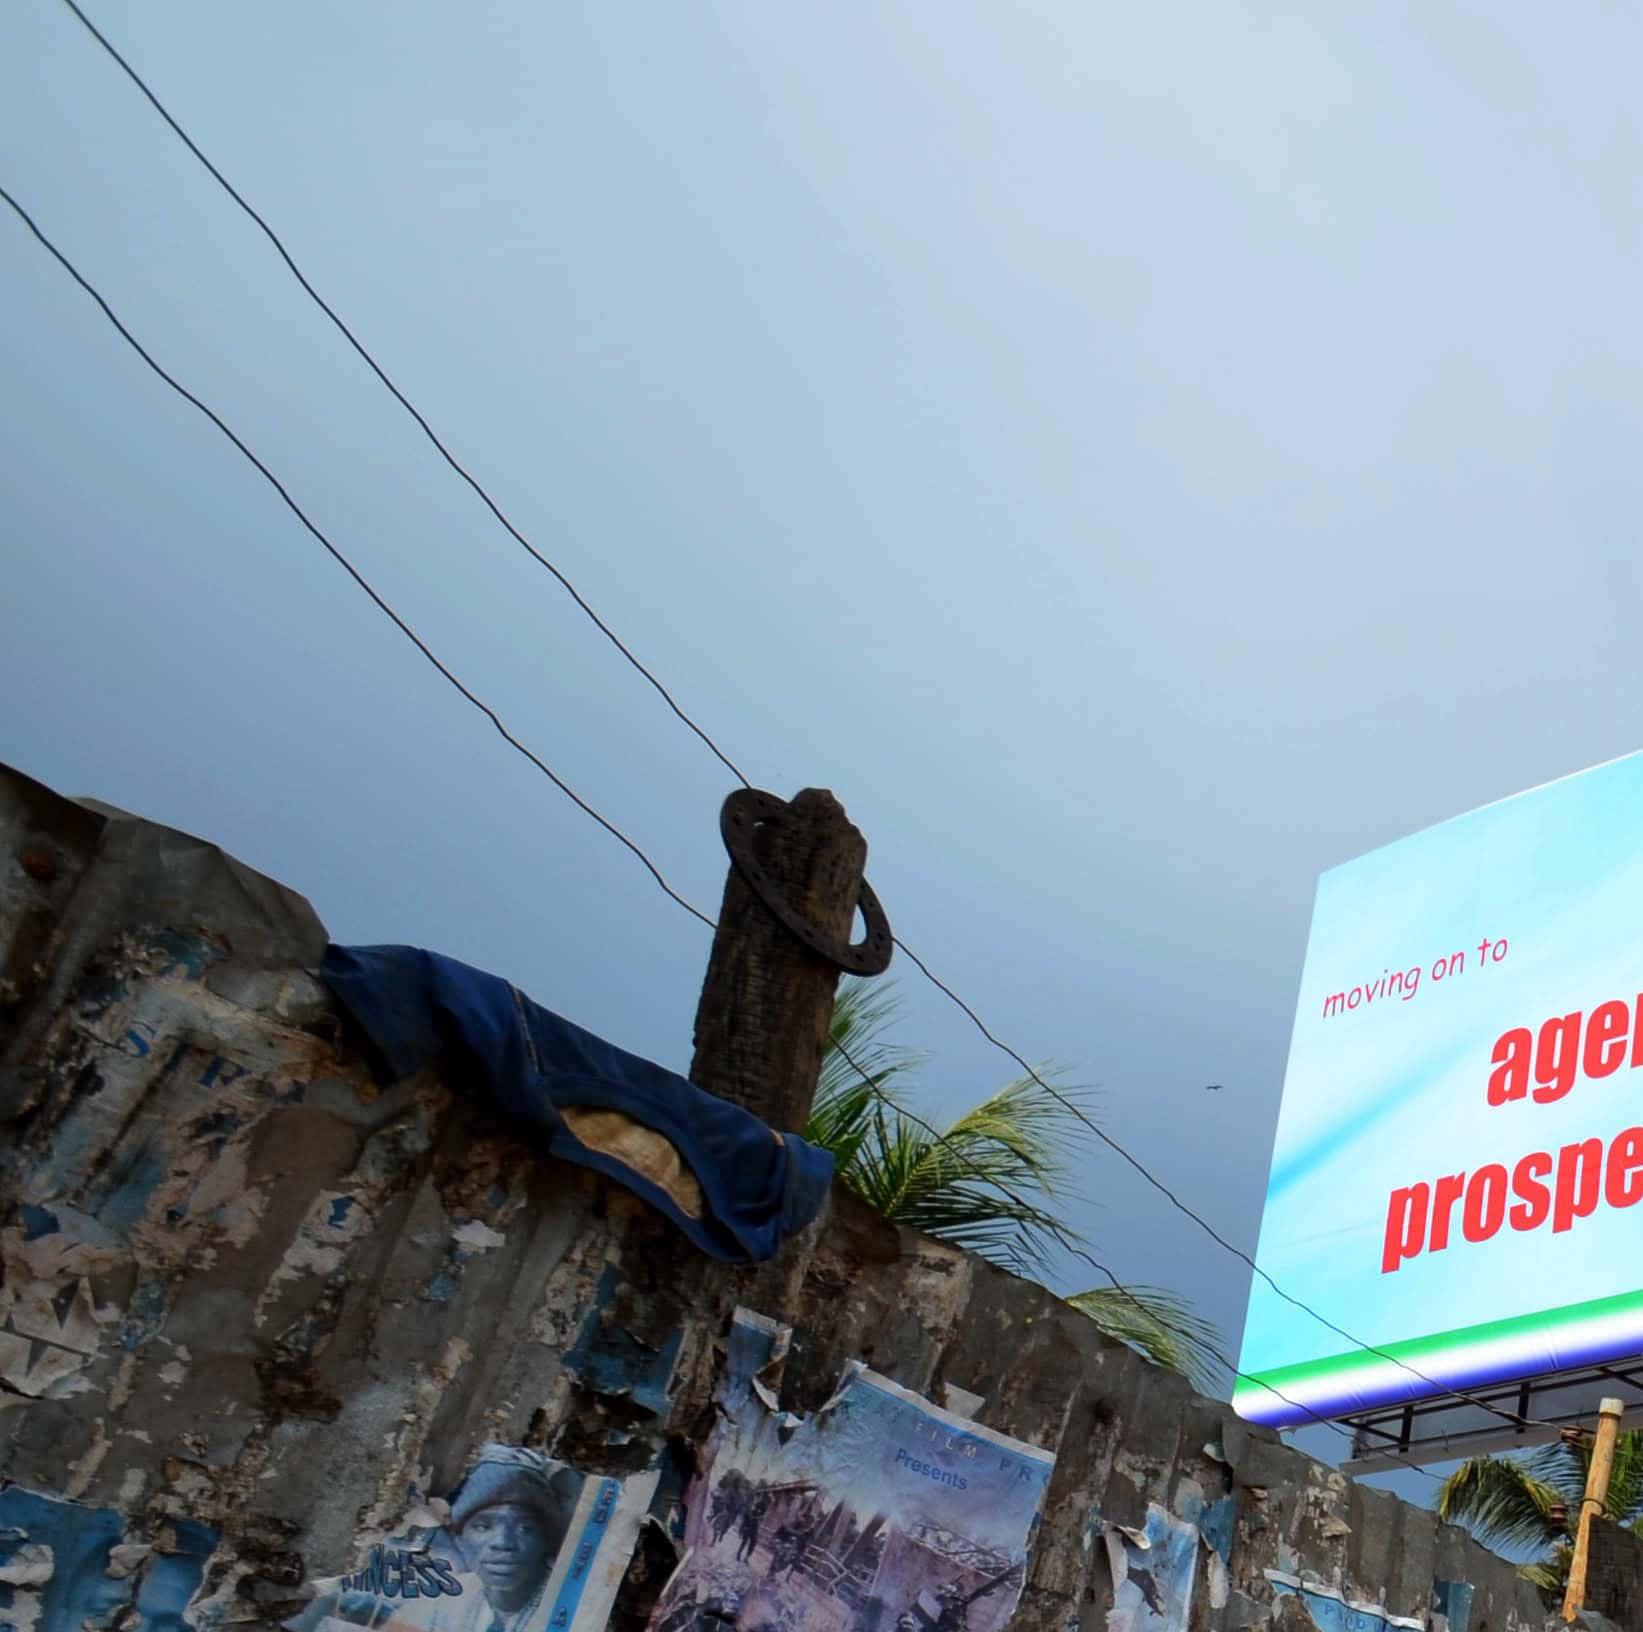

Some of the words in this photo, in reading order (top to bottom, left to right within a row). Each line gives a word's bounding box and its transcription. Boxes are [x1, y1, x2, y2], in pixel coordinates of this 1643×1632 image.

[1322, 965, 1419, 1018] moving
[1430, 948, 1465, 978] on
[1477, 935, 1509, 969] to
